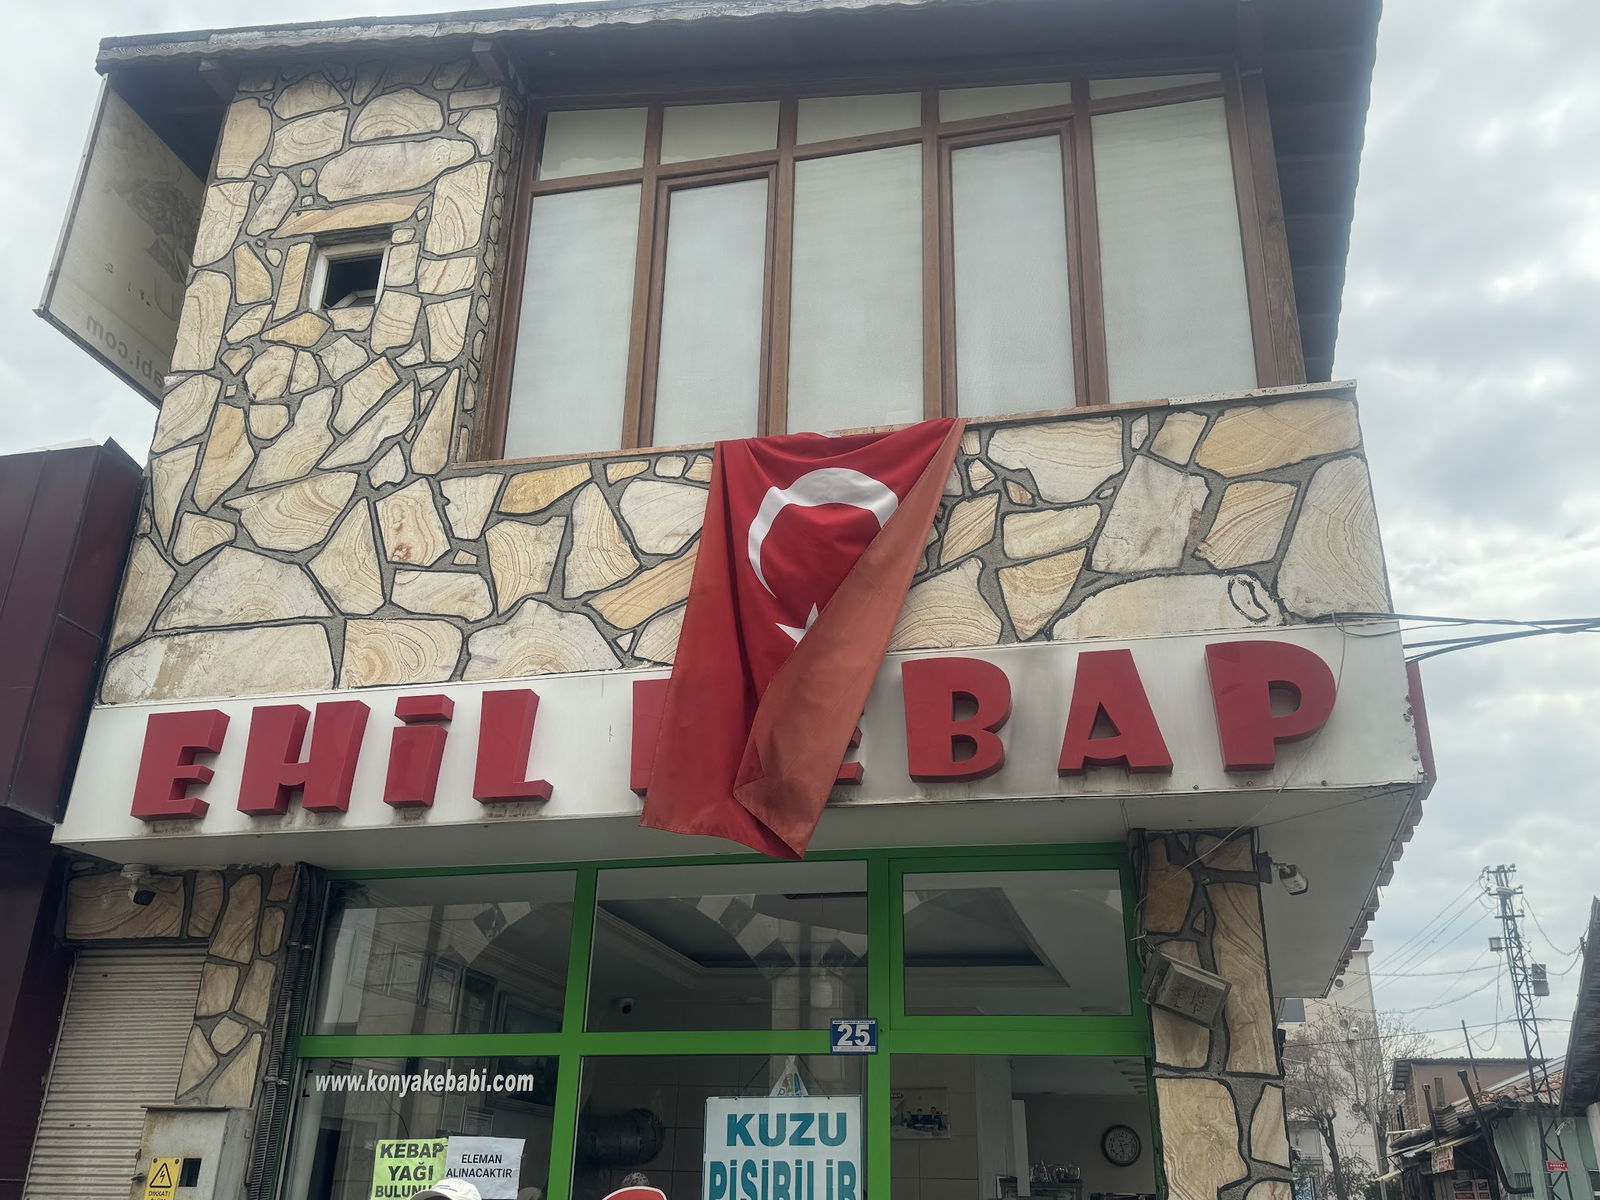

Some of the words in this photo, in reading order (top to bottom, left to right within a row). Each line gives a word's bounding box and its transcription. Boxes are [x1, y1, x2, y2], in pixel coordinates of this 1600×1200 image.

[631, 640, 1337, 798] BAP
[837, 1024, 871, 1046] 25
[315, 1068, 534, 1098] www.konyakebabi.com
[726, 1112, 847, 1147] KUZU
[380, 1143, 445, 1158] KEBAP
[461, 1154, 503, 1164] ELEMAN
[388, 1162, 434, 1181] YAĞI
[446, 1168, 513, 1179] ALINACAKTIR
